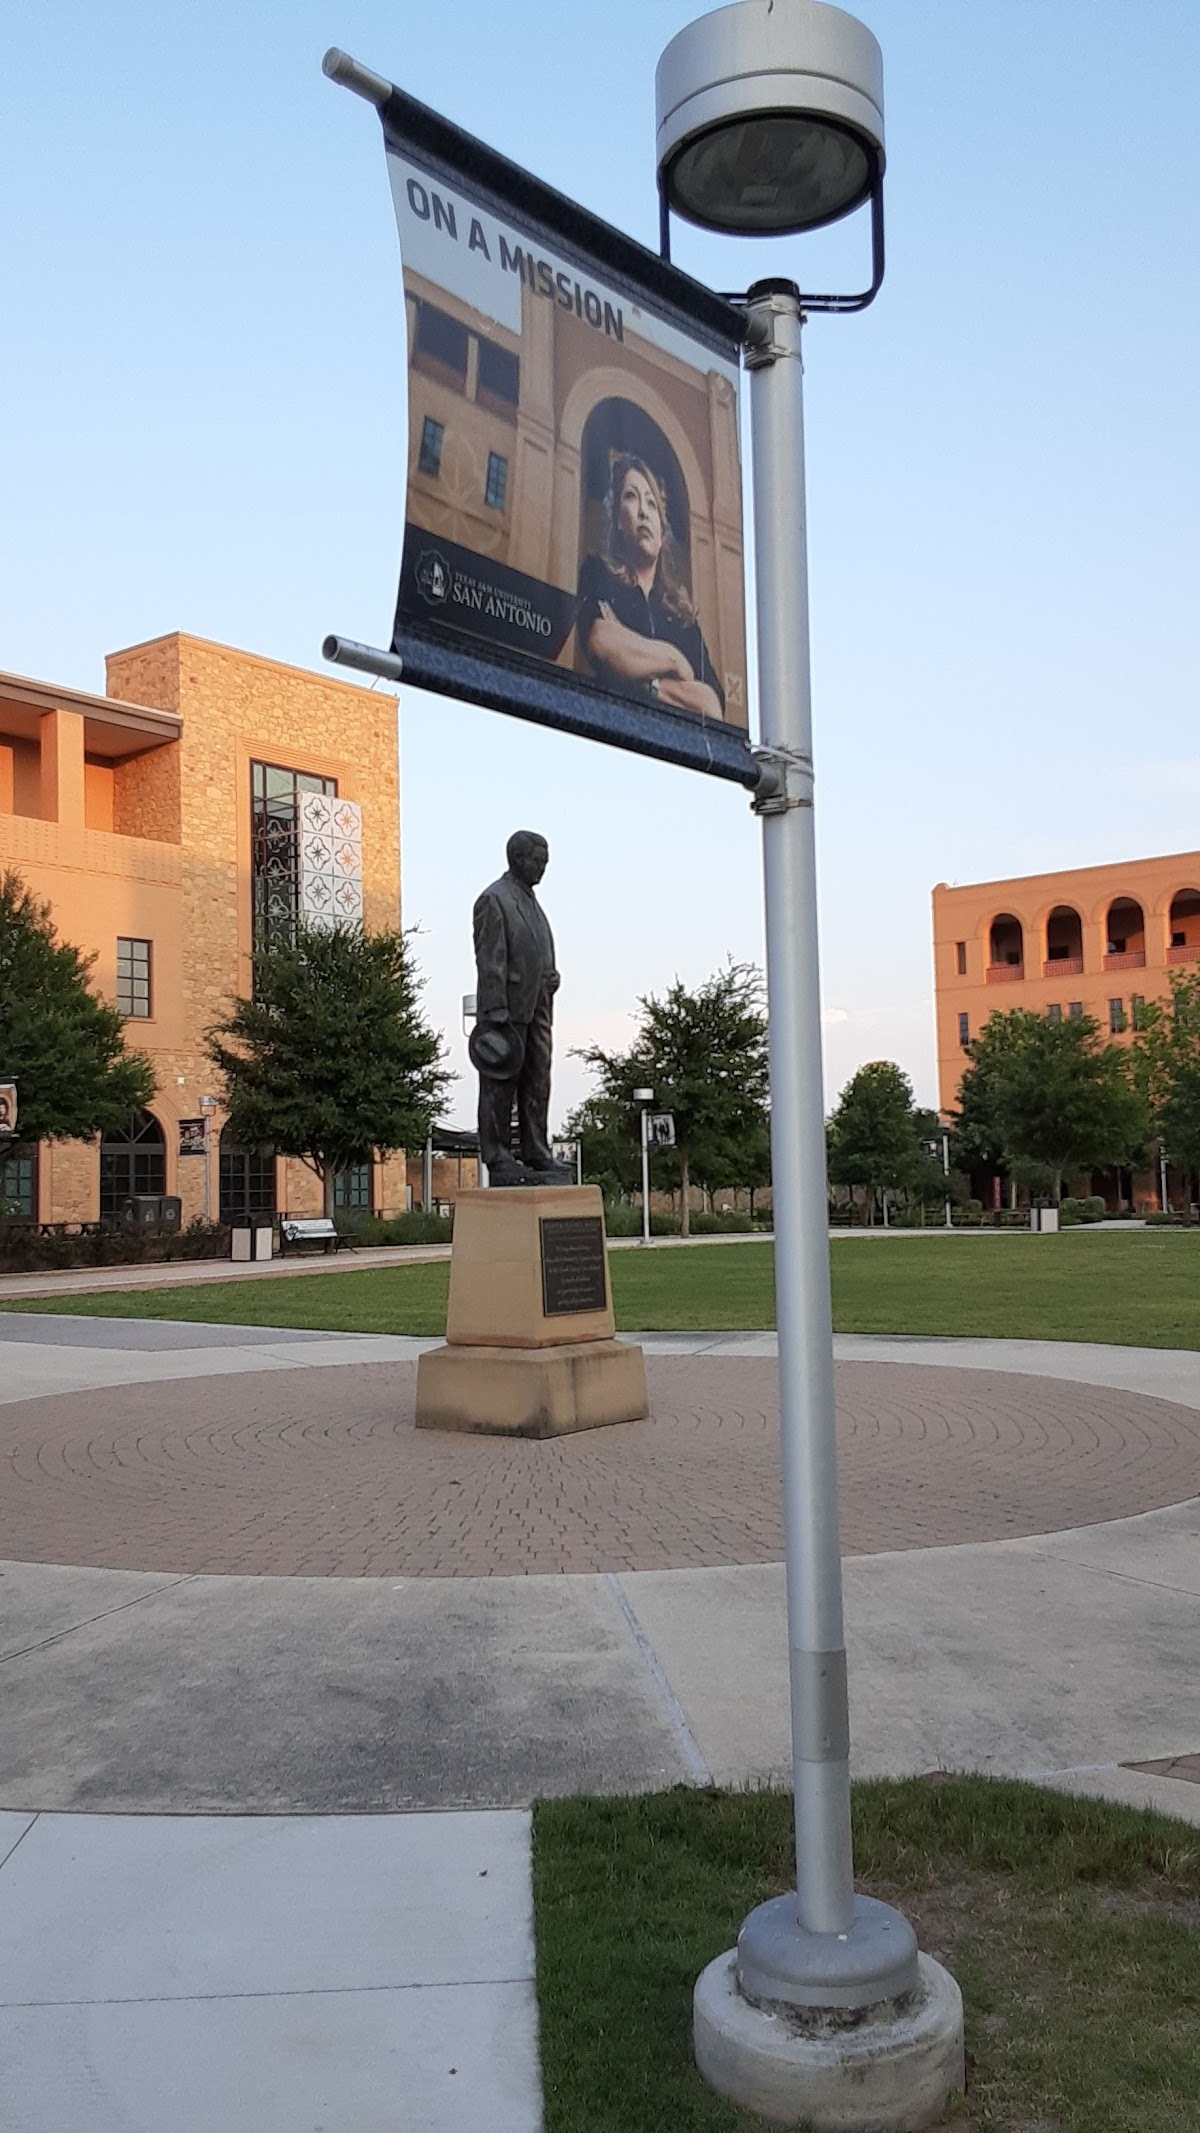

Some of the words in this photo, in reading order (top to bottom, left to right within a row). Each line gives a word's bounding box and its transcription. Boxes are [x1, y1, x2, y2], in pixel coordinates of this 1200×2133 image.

[406, 178, 458, 241] ON
[468, 217, 492, 263] A
[499, 234, 624, 343] MISSION
[452, 581, 483, 610] SAN
[485, 595, 552, 637] ANTONIO
[455, 572, 476, 587] TEXAS
[477, 582, 493, 594] A&M
[494, 587, 532, 610] UNIVERSITY
